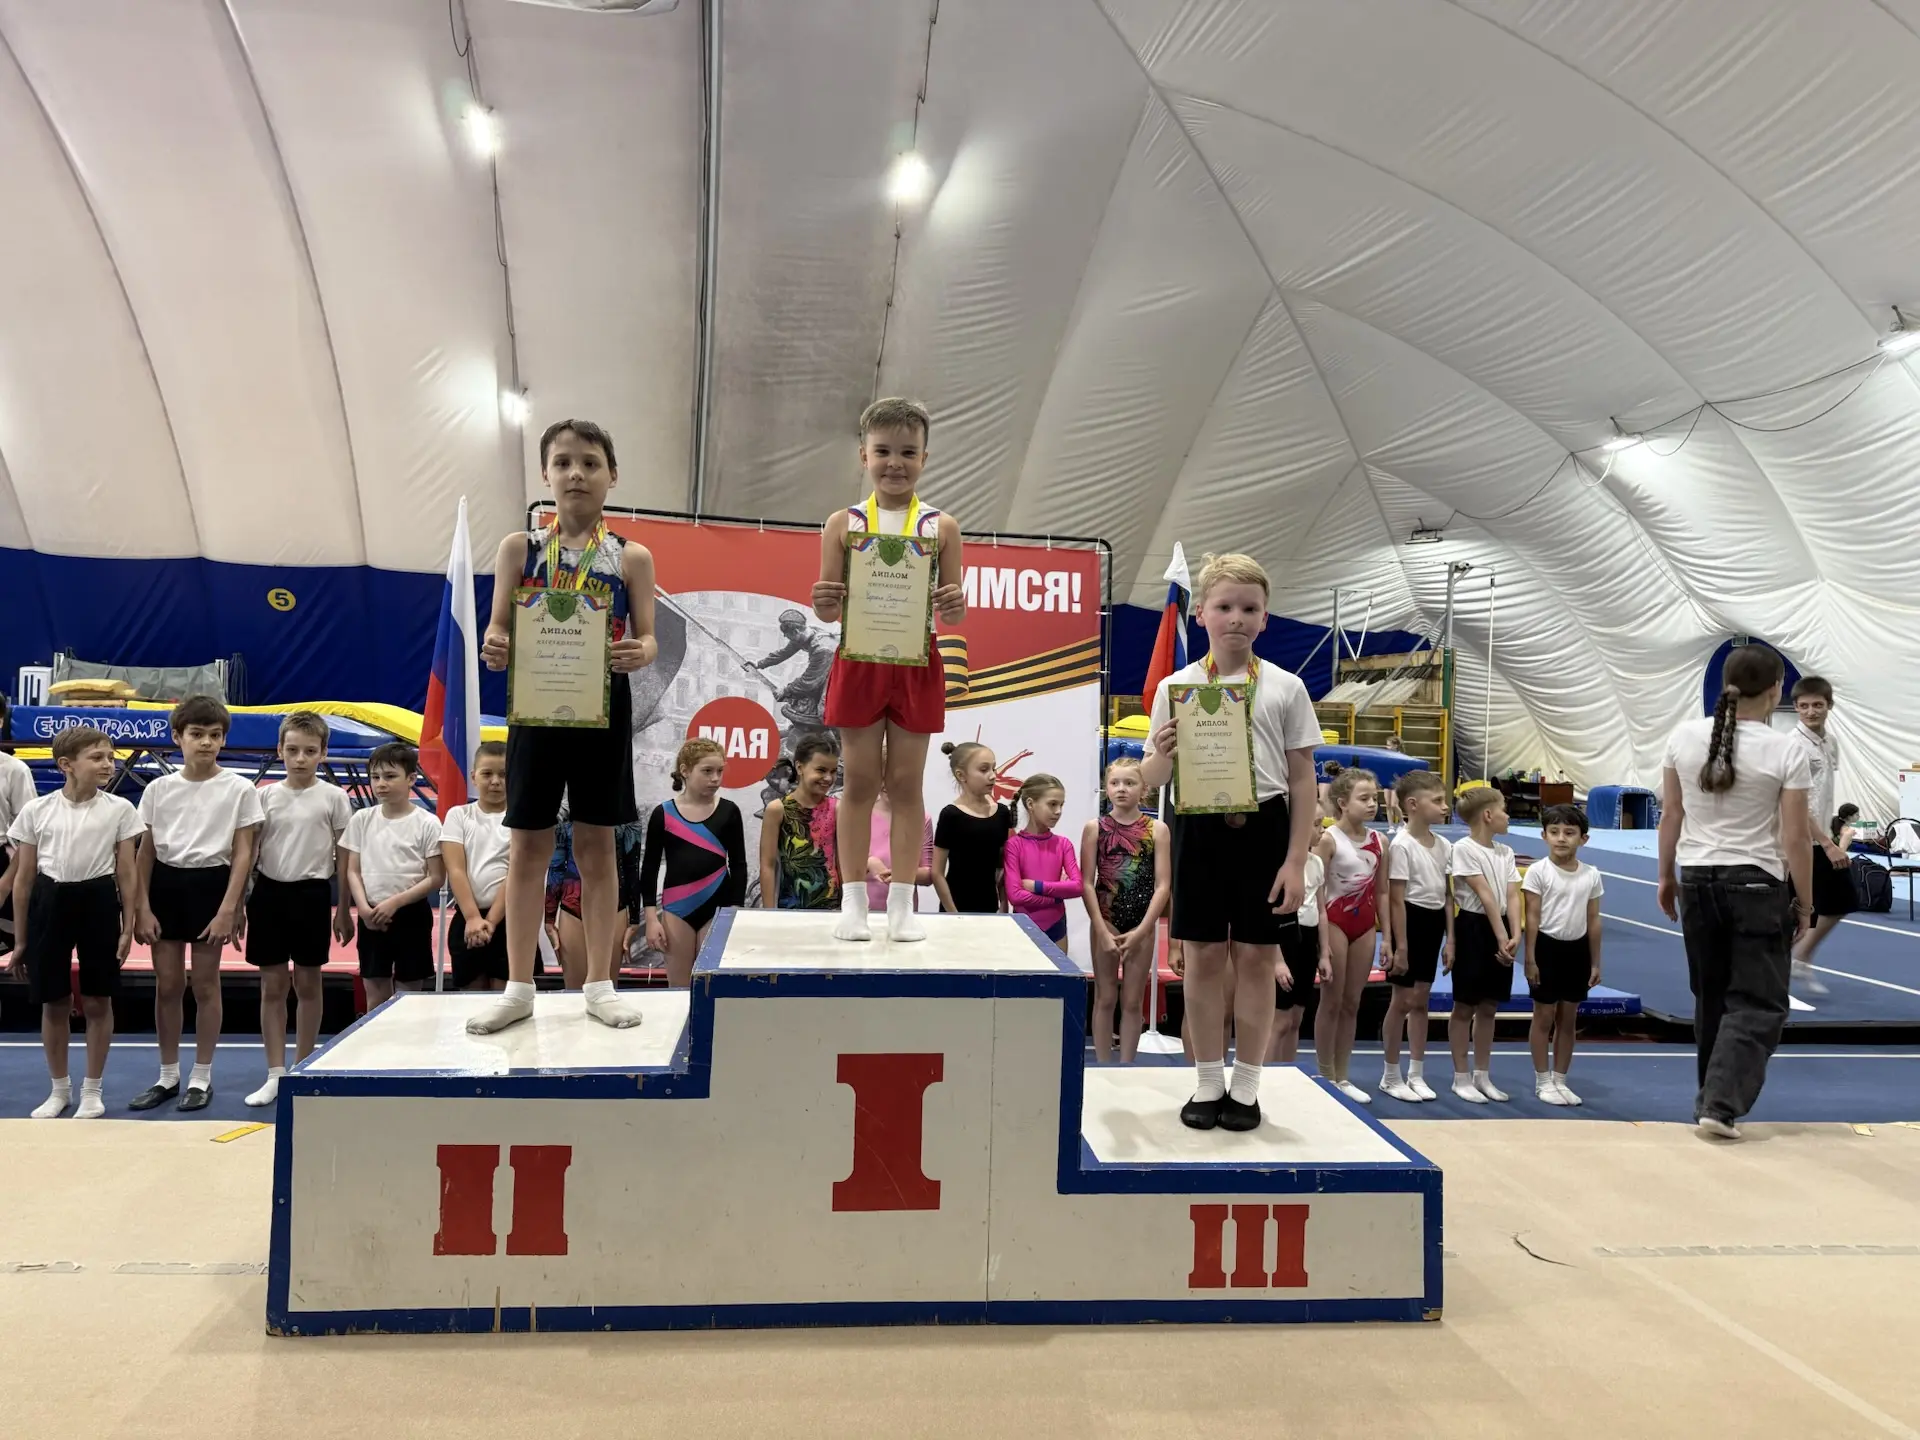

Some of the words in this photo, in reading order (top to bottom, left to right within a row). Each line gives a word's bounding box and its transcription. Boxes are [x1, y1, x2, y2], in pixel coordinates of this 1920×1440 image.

[872, 571, 908, 579] ДИПЛОМ
[274, 592, 290, 607] 5
[540, 627, 582, 635] ДИПЛОМ
[698, 725, 769, 760] МАЯ
[832, 1053, 944, 1211] I
[433, 1145, 572, 1256] II
[1188, 1205, 1310, 1288] III
